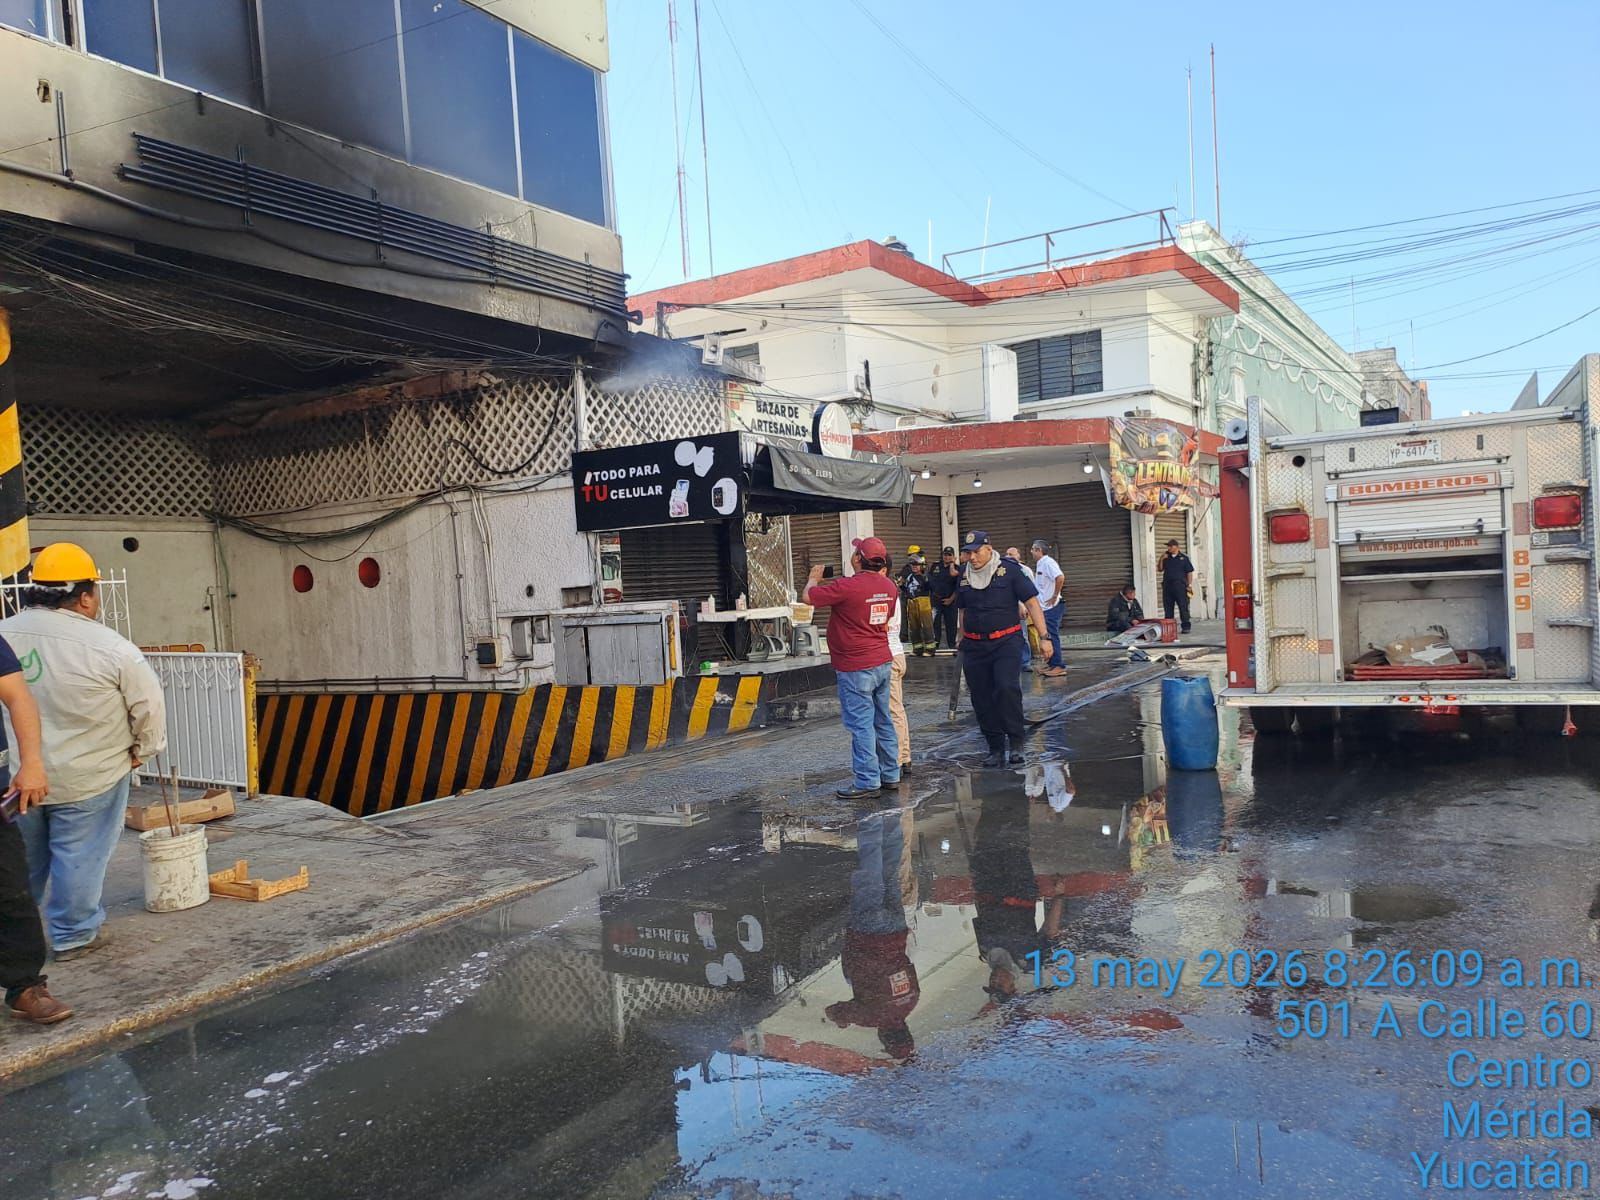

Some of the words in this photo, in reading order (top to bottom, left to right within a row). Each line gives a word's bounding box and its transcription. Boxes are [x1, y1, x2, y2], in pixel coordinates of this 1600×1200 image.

[755, 400, 787, 416] BAZAR
[787, 405, 799, 418] DE
[1390, 444, 1439, 459] YP-6417-E
[594, 469, 627, 482] TODO
[629, 463, 661, 479] PARA
[581, 484, 609, 503] TU
[610, 485, 663, 500] CELULAR
[1349, 474, 1489, 496] BOMBEROS
[1358, 537, 1479, 552] www.ssp.yucatan.gob.mx
